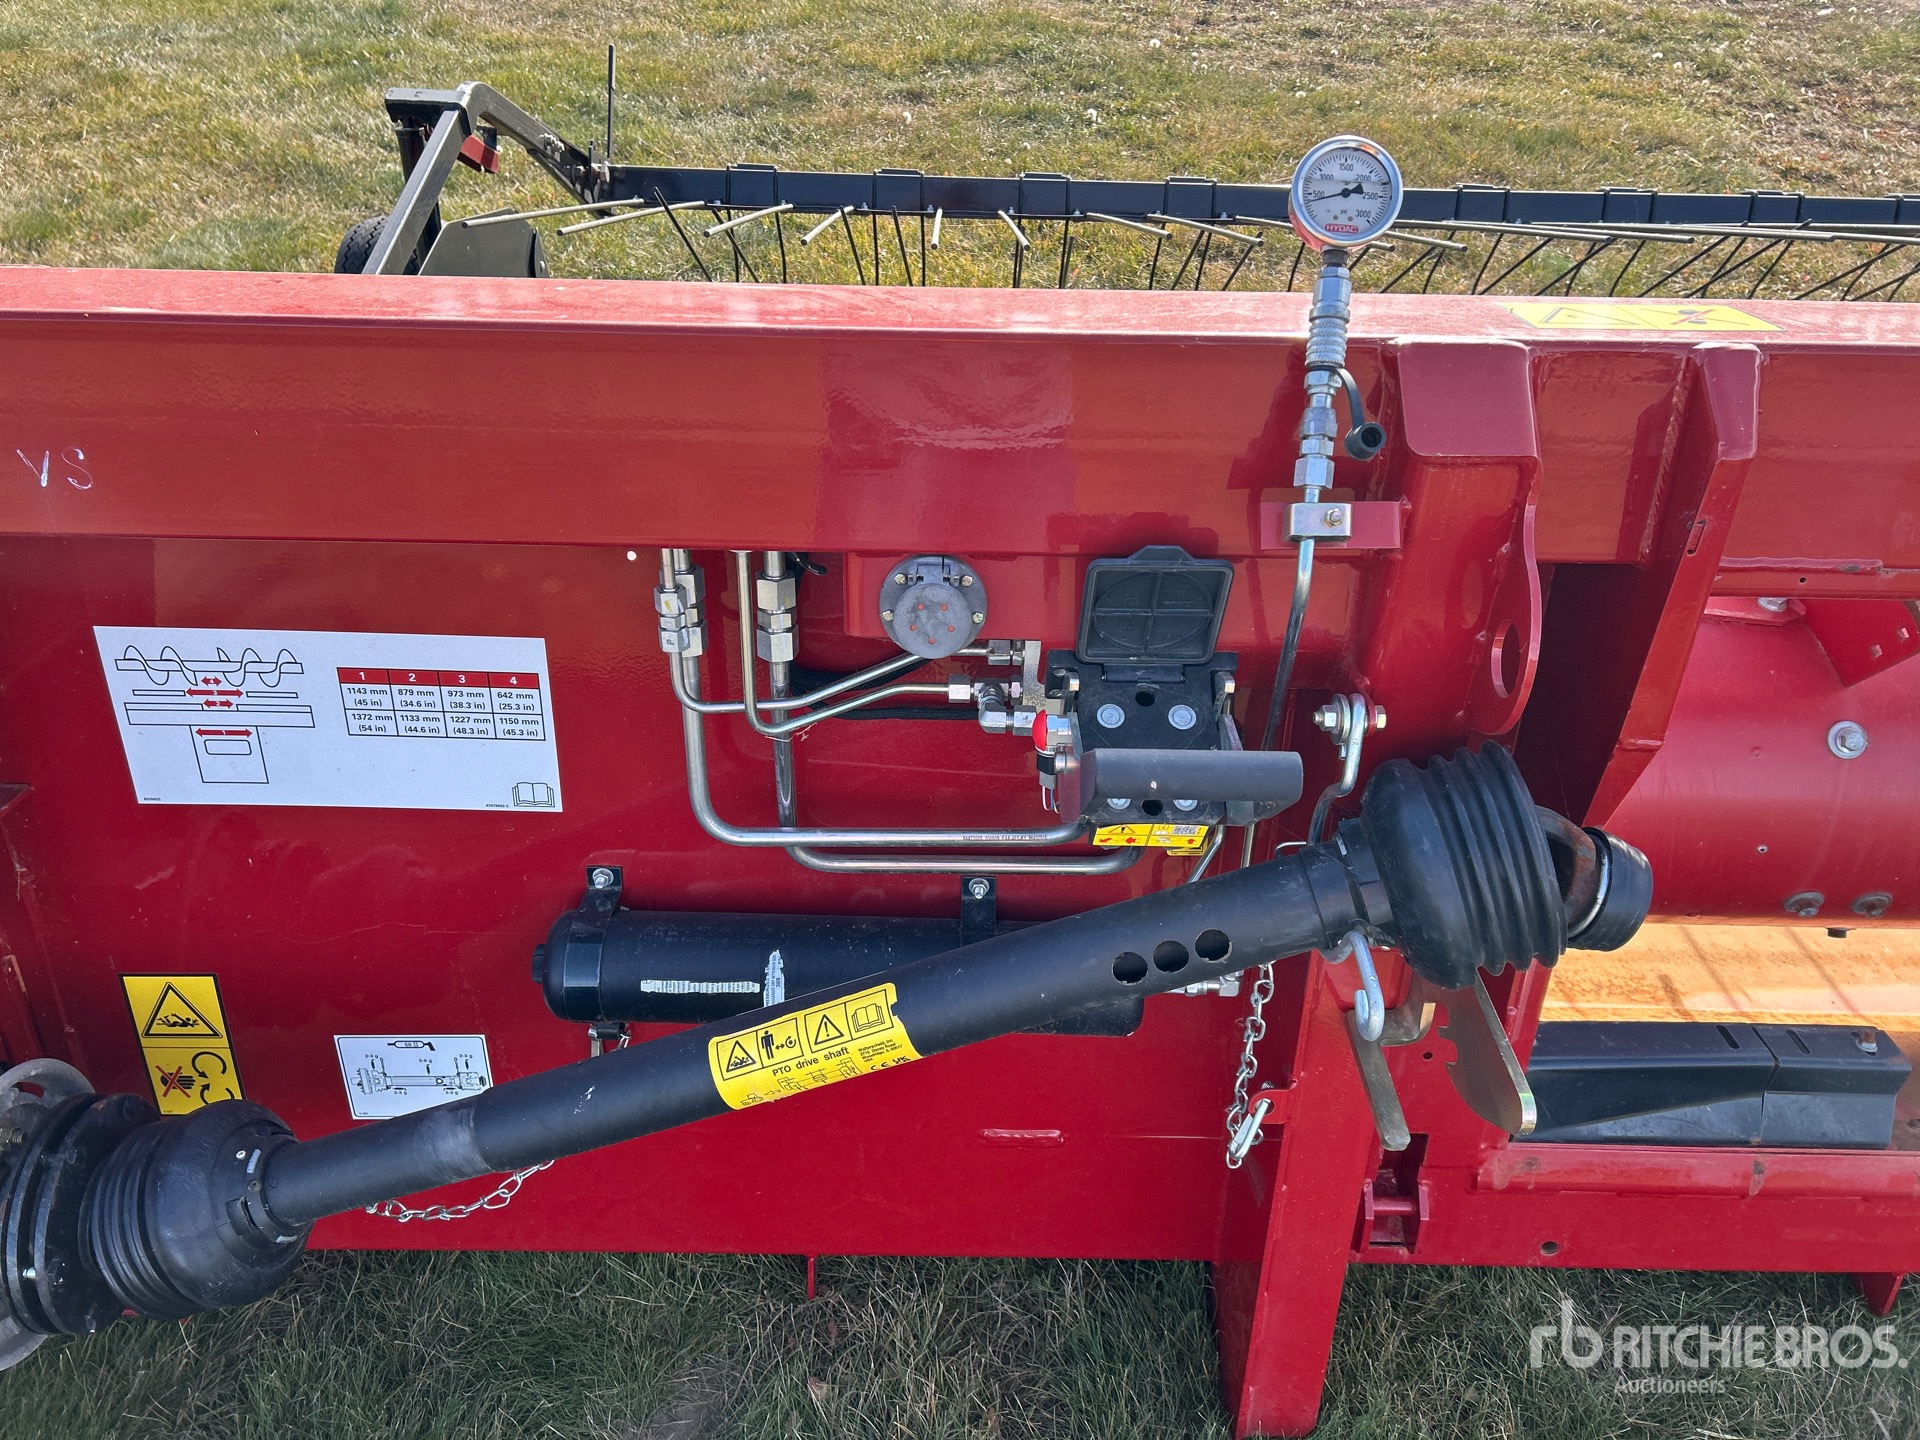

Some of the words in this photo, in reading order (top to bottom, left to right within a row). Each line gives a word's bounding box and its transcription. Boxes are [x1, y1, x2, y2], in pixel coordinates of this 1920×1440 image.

[1339, 163, 1353, 171] 1500
[1362, 192, 1378, 200] 2500
[1356, 210, 1371, 218] 3000
[1326, 224, 1357, 233] HYDAC
[358, 672, 366, 680] 1
[408, 673, 416, 682] 2
[458, 674, 466, 684] 3
[510, 676, 518, 685] 4
[347, 687, 367, 695] 1143
[354, 698, 368, 706] (45
[370, 699, 382, 707] in)
[400, 700, 422, 708] (34.6
[424, 700, 436, 708] in)
[450, 702, 472, 710] (38.3
[474, 702, 486, 710] in)
[499, 702, 520, 710] (25.3
[523, 704, 534, 712] in)
[358, 724, 372, 732] (54
[375, 725, 386, 733] in)
[404, 726, 426, 734] (44.6
[428, 726, 440, 734] in)
[477, 728, 488, 736] in)
[502, 728, 524, 736] (45.3
[772, 1065, 792, 1076] PTO
[796, 1058, 819, 1070] drive
[824, 1046, 850, 1060] shaft
